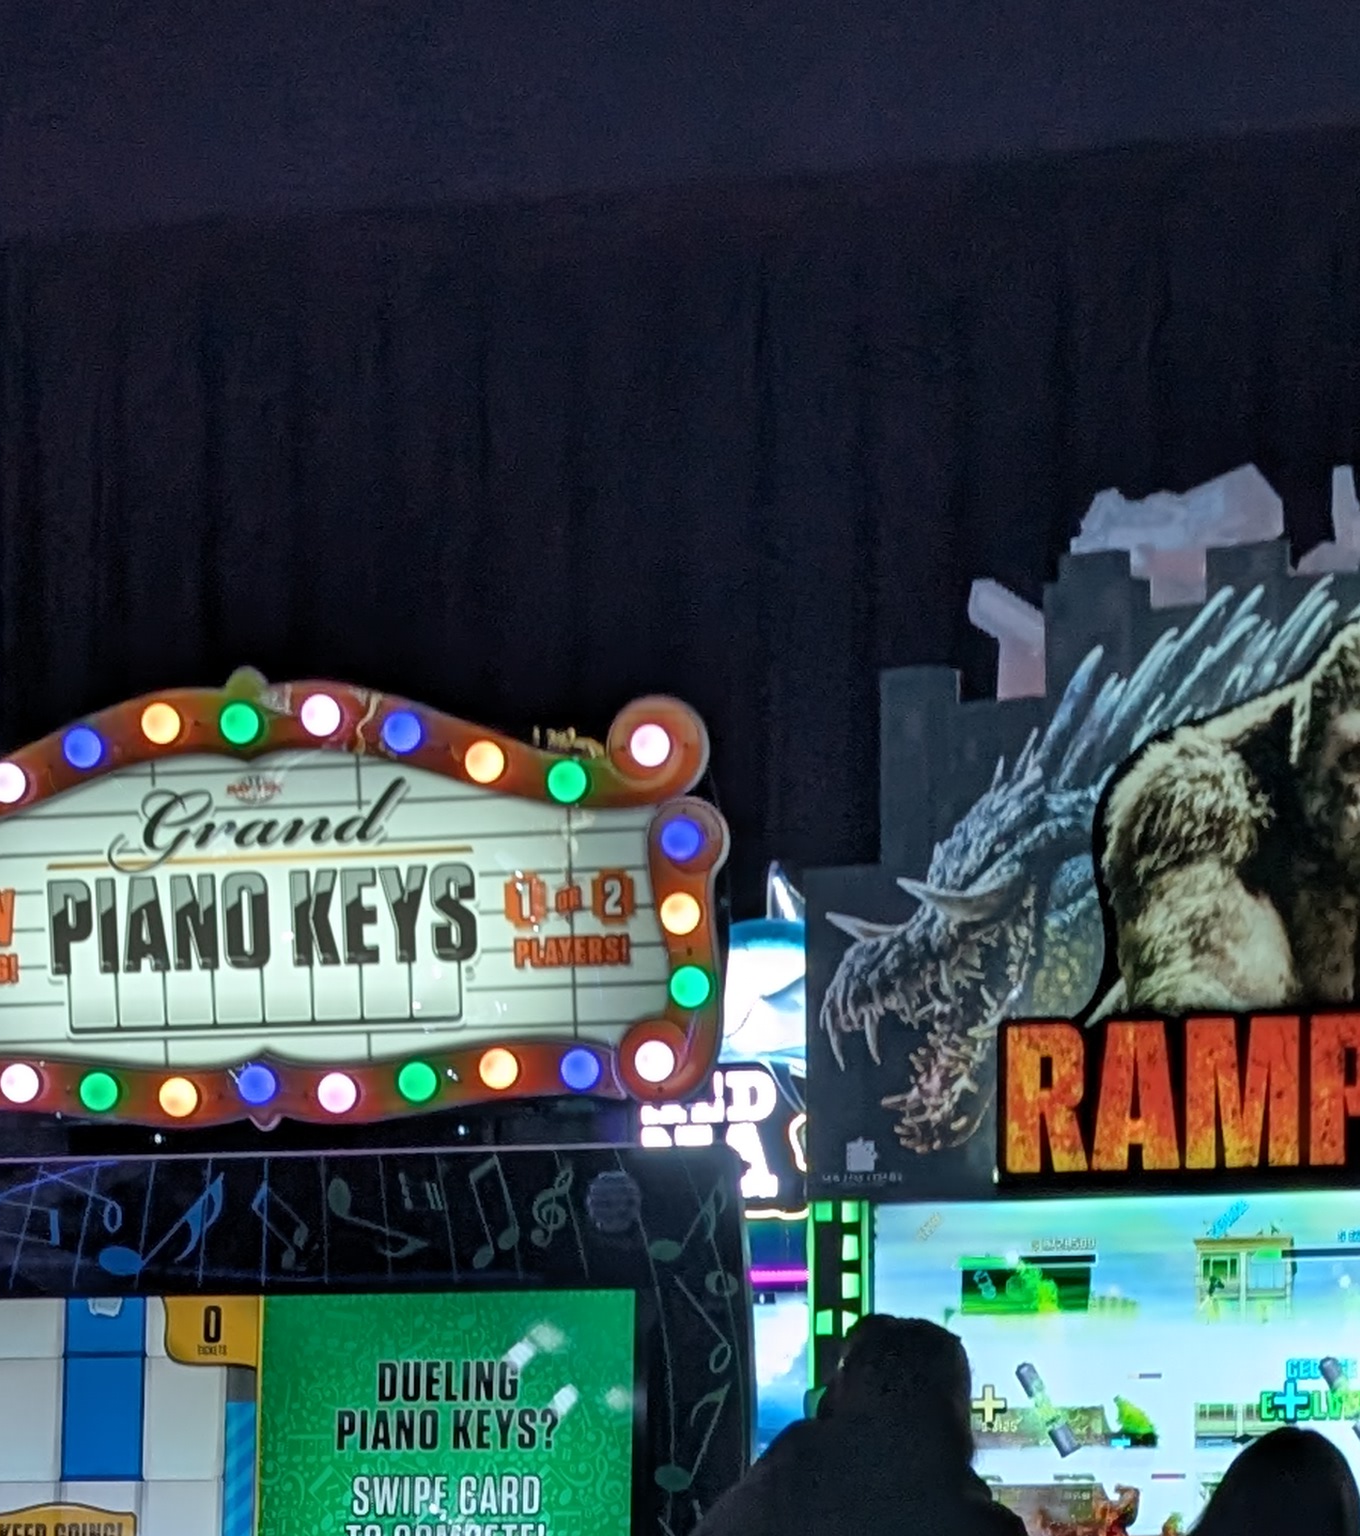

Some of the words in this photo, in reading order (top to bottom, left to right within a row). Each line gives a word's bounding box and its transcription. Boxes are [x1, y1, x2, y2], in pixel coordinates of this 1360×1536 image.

[108, 777, 407, 873] Grand
[48, 870, 271, 976] PIANO
[289, 862, 478, 968] KEYS
[514, 933, 631, 969] PLAYERS!
[203, 1305, 222, 1343] 0
[377, 1361, 519, 1402] DUELING
[336, 1410, 439, 1450] PIANO
[452, 1408, 558, 1449] KEYS?
[352, 1475, 448, 1516] SWIPE
[459, 1475, 541, 1515] CARD
